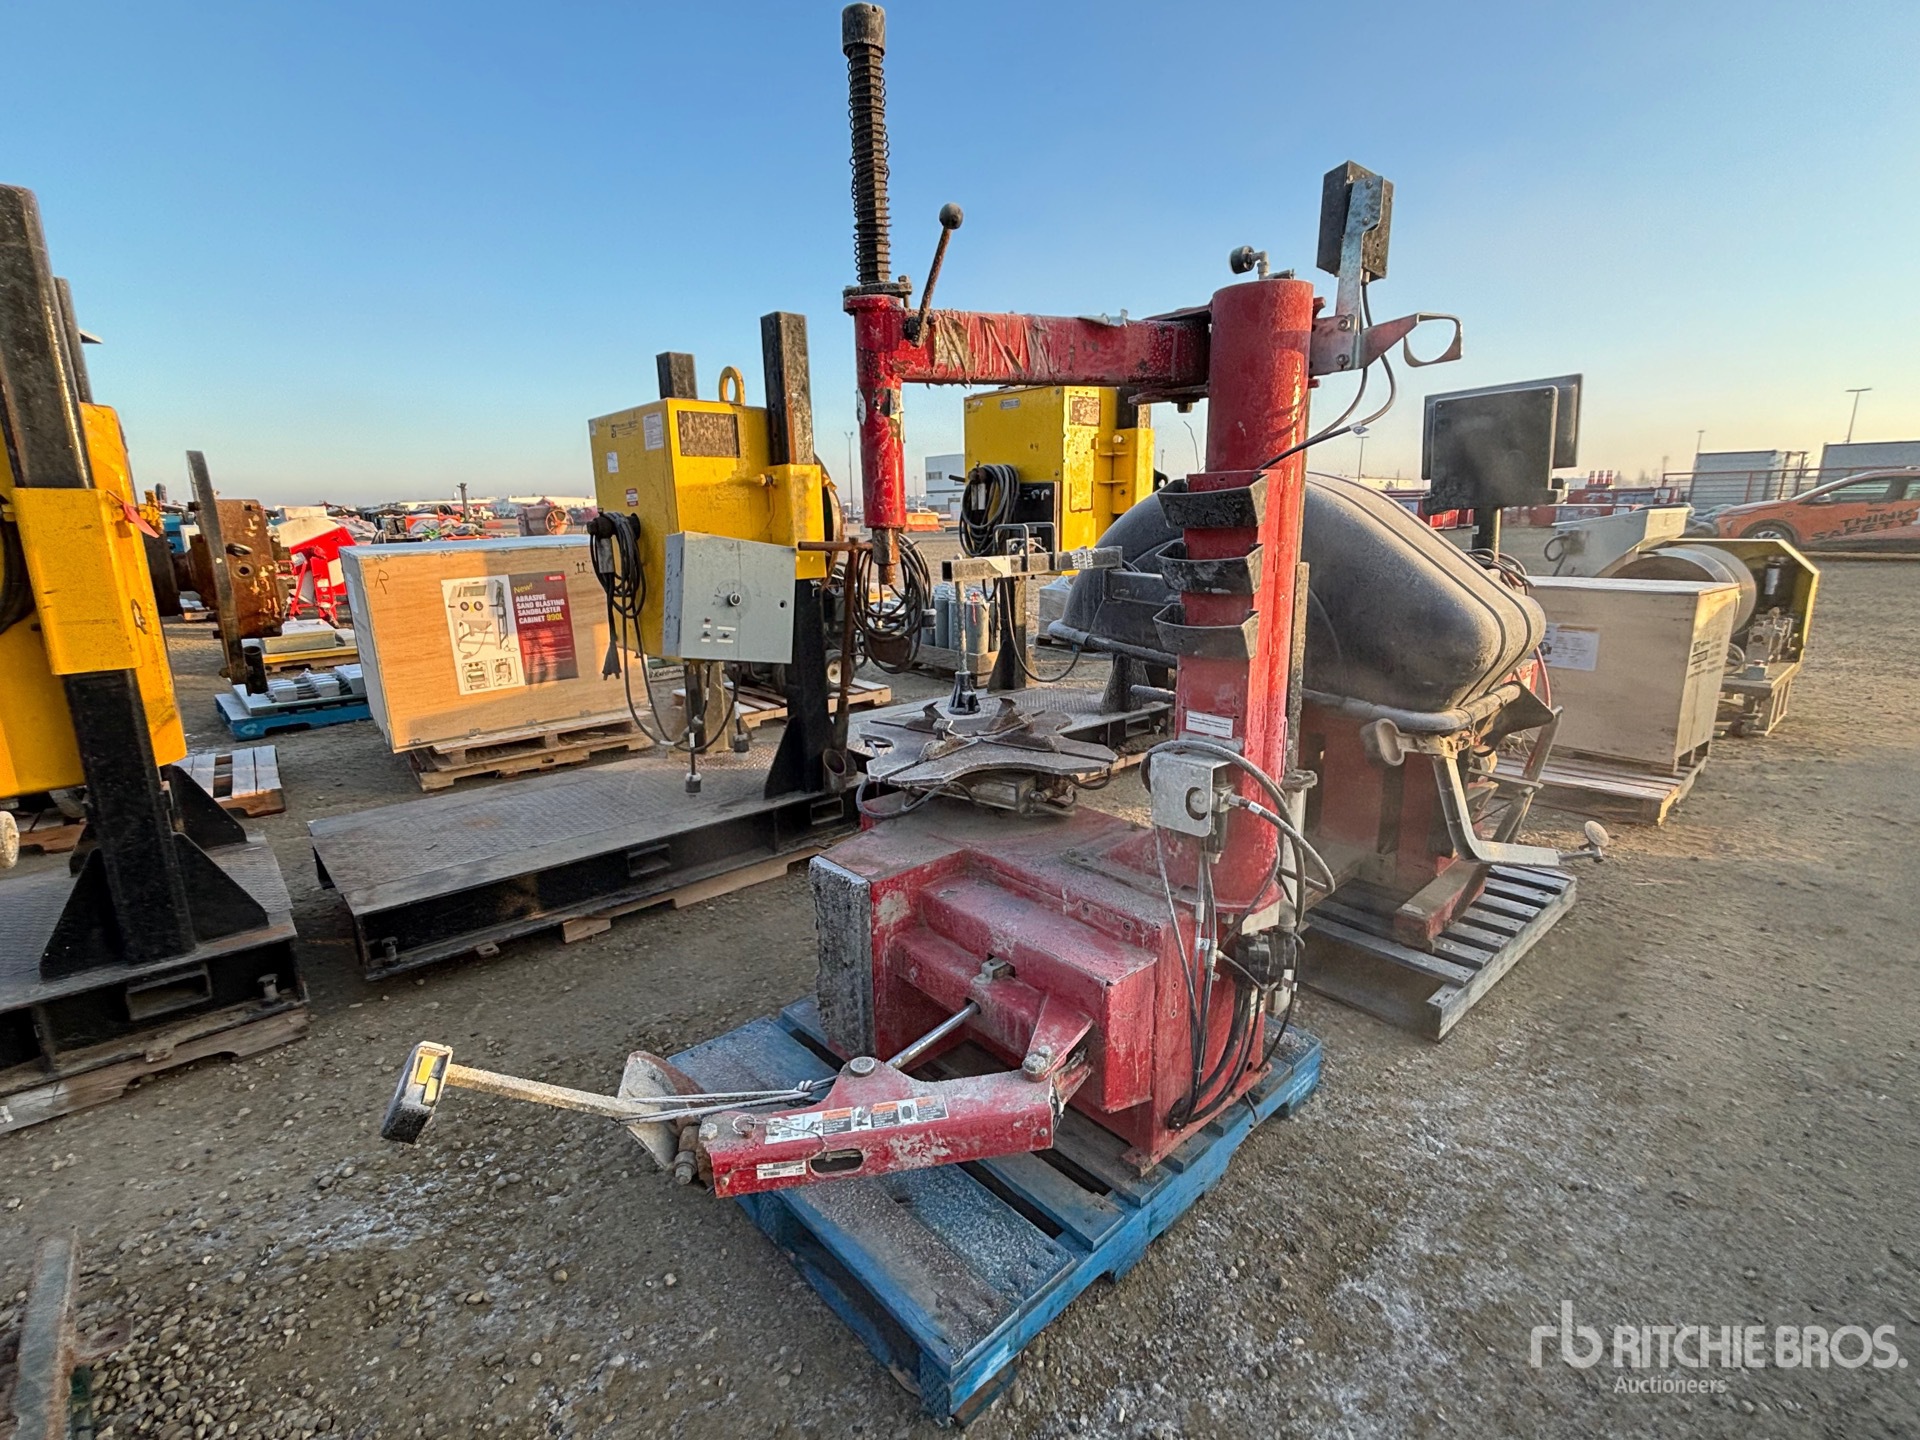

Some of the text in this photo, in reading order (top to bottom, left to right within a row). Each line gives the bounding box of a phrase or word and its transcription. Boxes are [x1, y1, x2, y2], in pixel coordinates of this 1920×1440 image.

[1839, 508, 1915, 528] THINK
[1811, 518, 1912, 541] SAFETY
[513, 582, 533, 594] New!
[515, 593, 546, 603] ABRASIVE
[516, 598, 565, 610] SAND BLASTING
[517, 606, 561, 616] SANDBLASTER
[518, 615, 545, 625] CABINET
